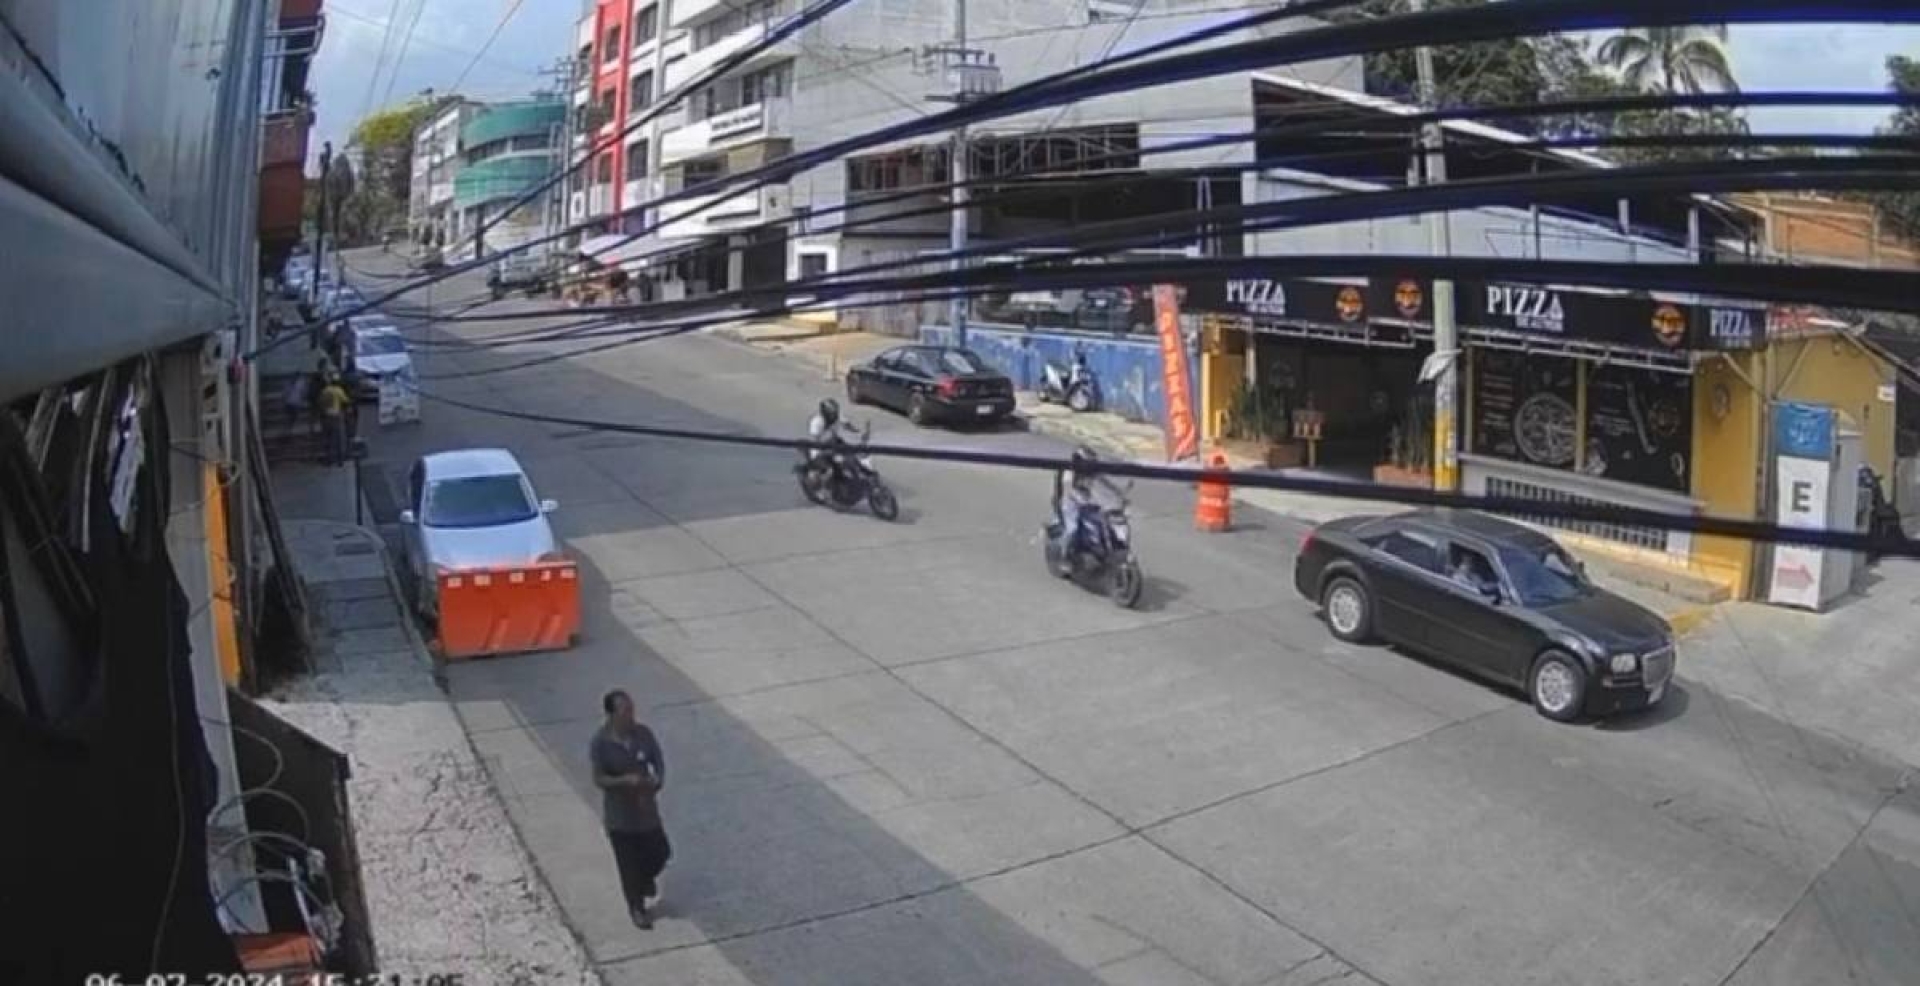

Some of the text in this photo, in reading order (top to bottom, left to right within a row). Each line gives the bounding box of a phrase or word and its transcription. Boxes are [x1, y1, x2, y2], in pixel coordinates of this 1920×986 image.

[1226, 279, 1285, 306] PIZZA
[1487, 285, 1564, 319] PIZZA
[1709, 308, 1752, 336] PIZZA
[1791, 481, 1813, 513] E
